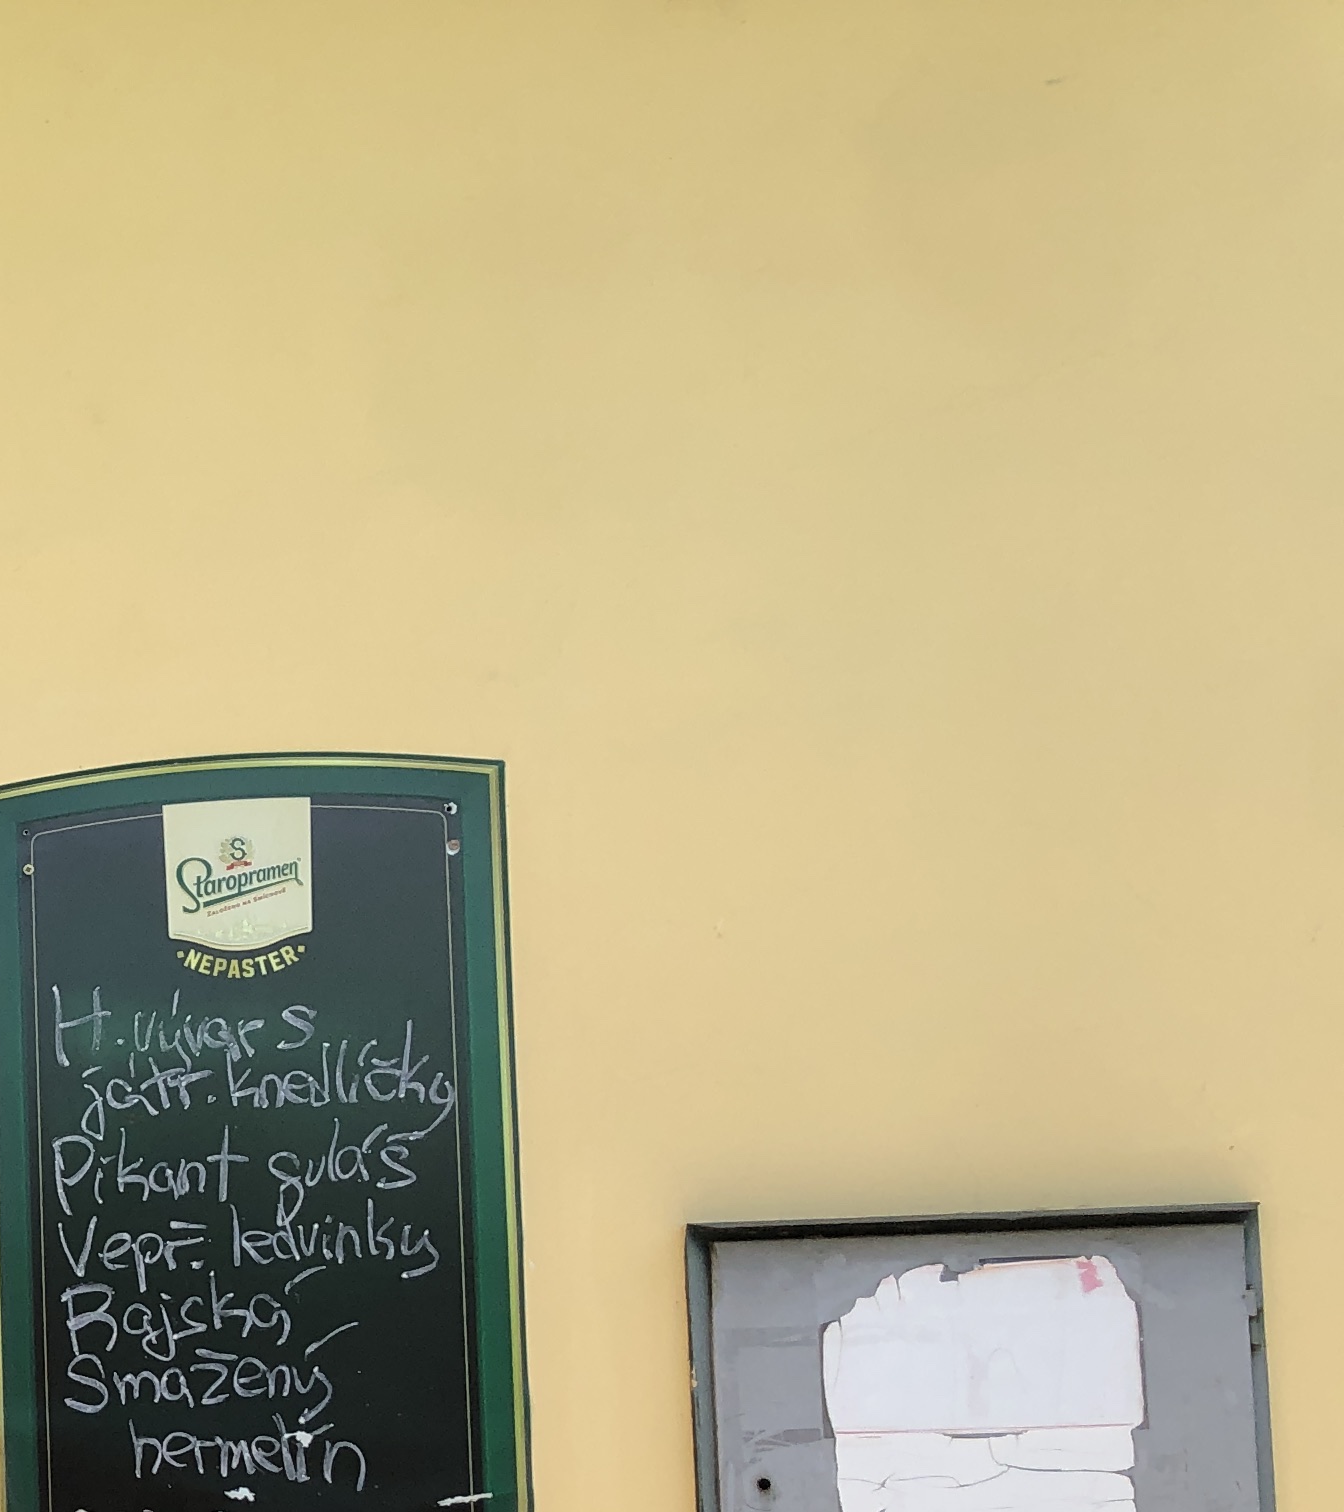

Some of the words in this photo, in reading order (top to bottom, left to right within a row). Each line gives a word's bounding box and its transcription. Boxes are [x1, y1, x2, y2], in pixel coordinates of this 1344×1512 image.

[229, 837, 247, 861] S
[176, 857, 303, 914] Staropramen
[183, 945, 299, 979] NEPASTER
[63, 1321, 360, 1424] Smažený
